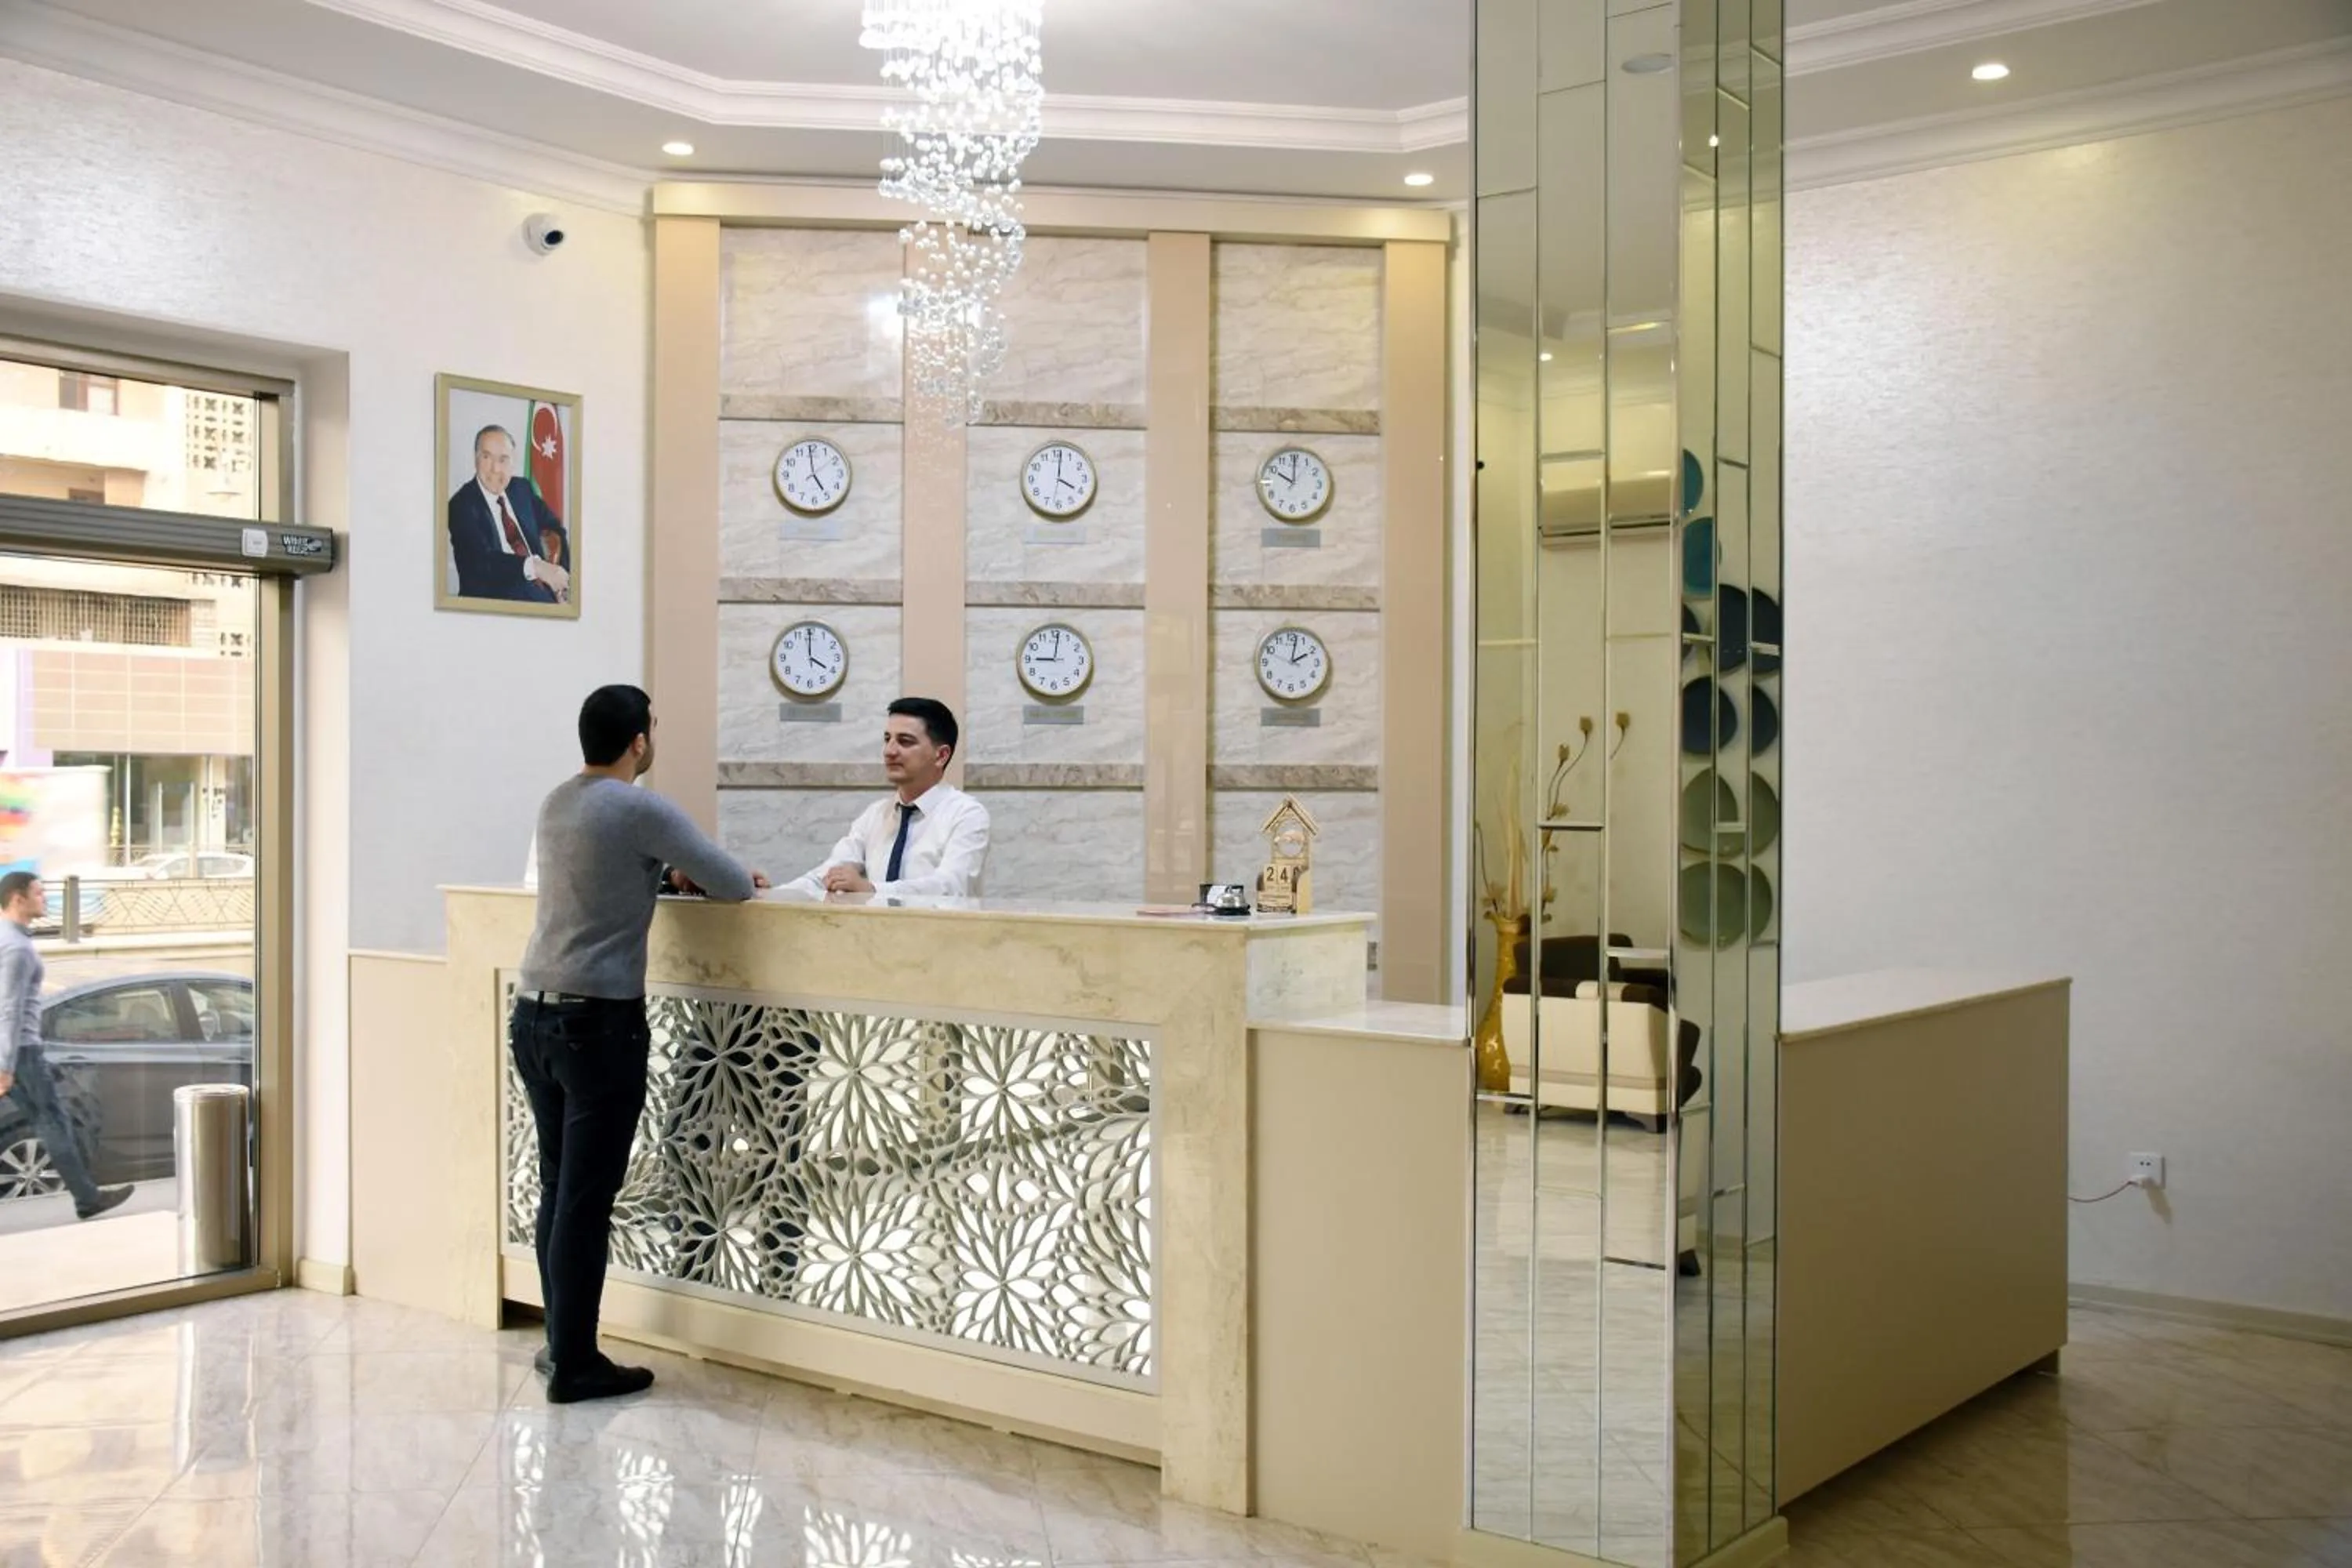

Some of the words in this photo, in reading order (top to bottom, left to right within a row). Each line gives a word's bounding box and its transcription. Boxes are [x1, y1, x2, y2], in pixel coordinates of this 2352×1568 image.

[796, 448, 803, 457] 11
[832, 456, 839, 465] 2
[1031, 463, 1040, 471] 10
[1076, 462, 1082, 470] 2
[782, 470, 789, 479] 9
[837, 469, 844, 477] 3
[1029, 475, 1034, 484] 9
[1081, 474, 1087, 483] 3
[788, 484, 794, 492] 8
[1316, 480, 1323, 489] 3
[1077, 486, 1083, 495] 4
[1044, 497, 1050, 506] 7
[1055, 499, 1062, 509] 6
[1068, 496, 1074, 505] 5
[1278, 499, 1284, 508] 7
[1289, 504, 1296, 513] 6
[794, 631, 801, 640] 11
[1040, 633, 1046, 642] 11
[784, 641, 793, 649] 10
[830, 641, 837, 649] 2
[1073, 644, 1080, 652] 2
[1079, 655, 1084, 665] 3
[1314, 659, 1320, 667] 3
[807, 679, 813, 688] 6
[1050, 681, 1057, 690] 6
